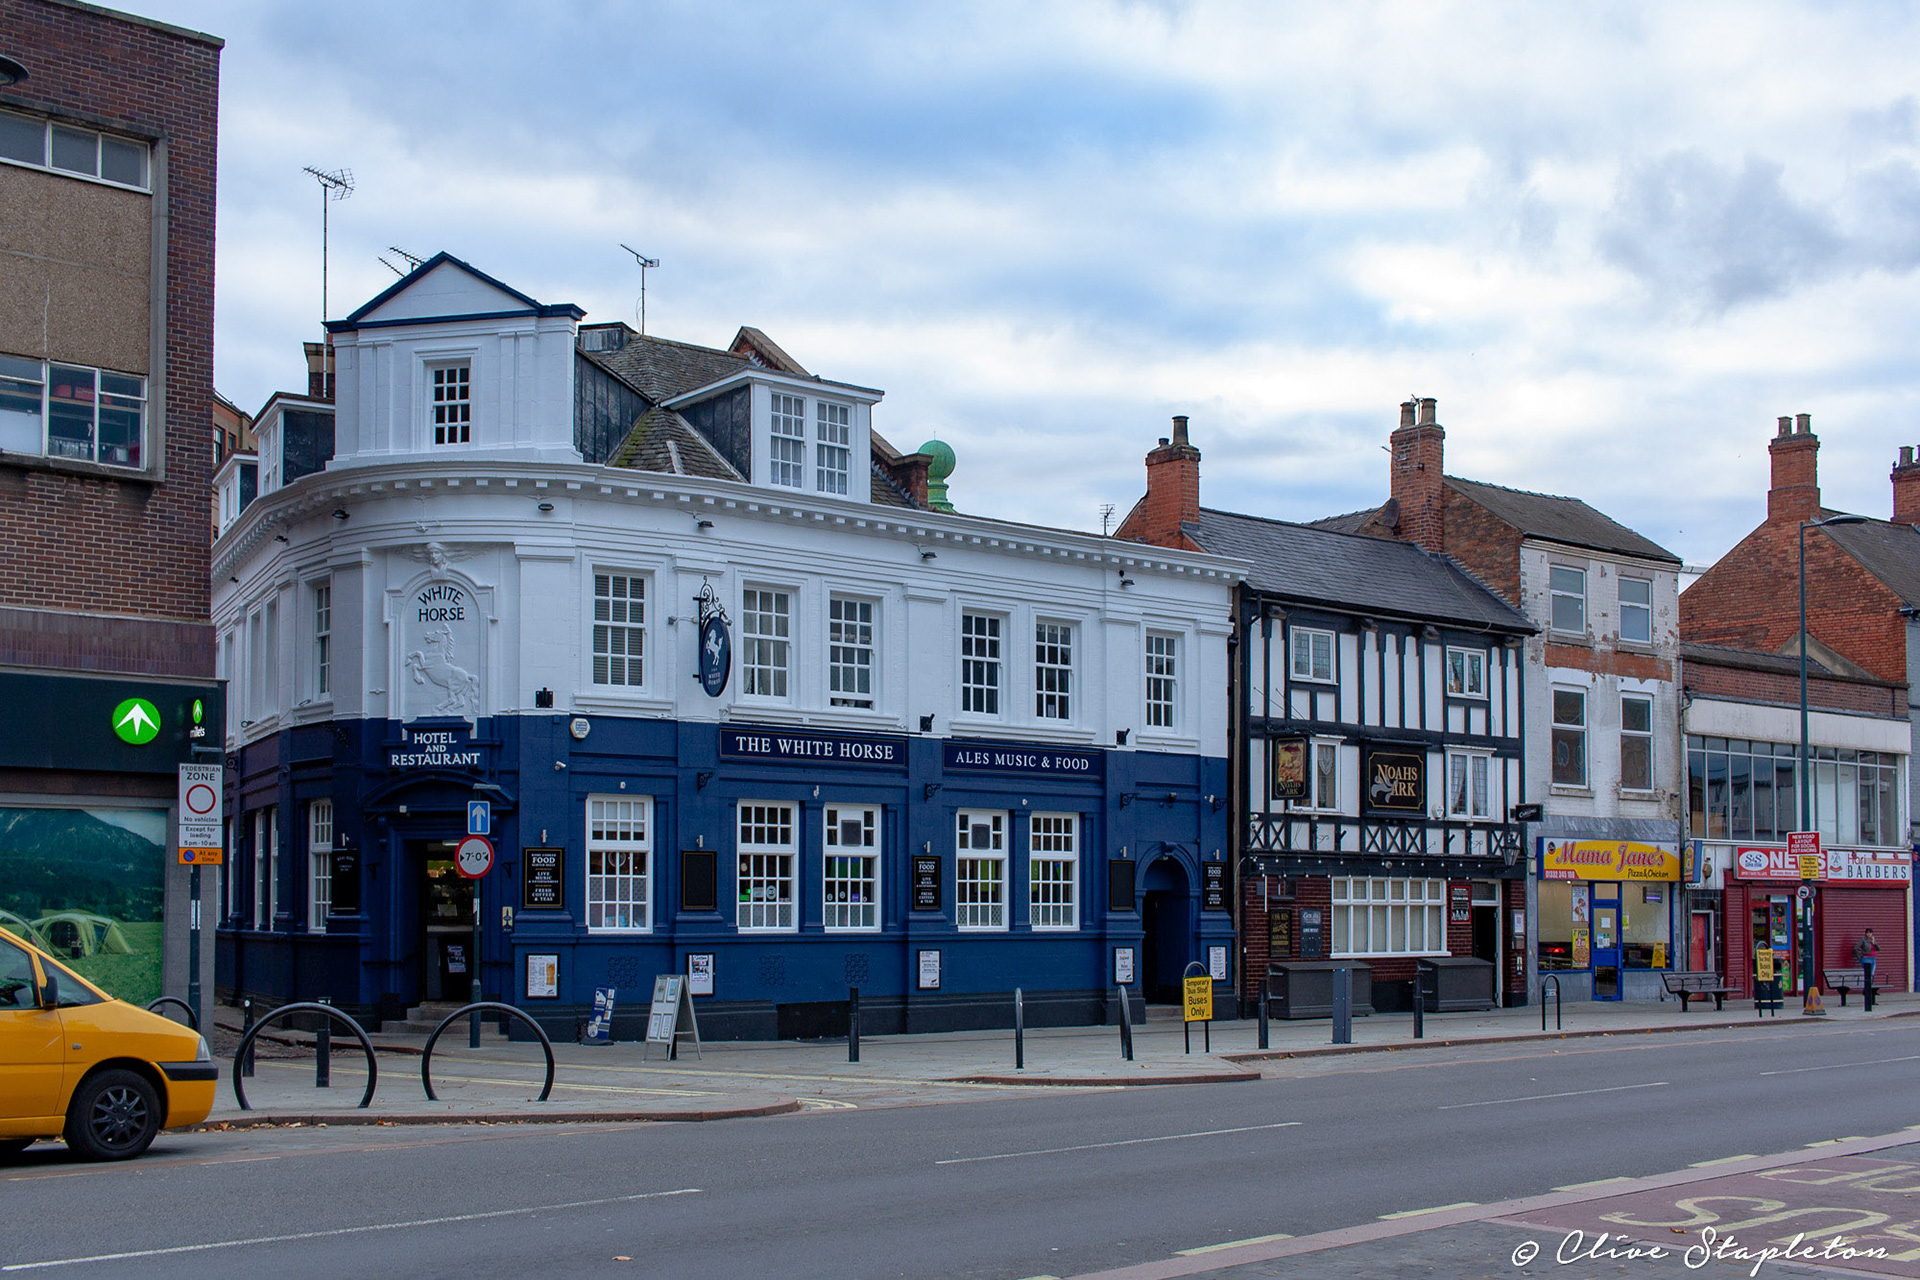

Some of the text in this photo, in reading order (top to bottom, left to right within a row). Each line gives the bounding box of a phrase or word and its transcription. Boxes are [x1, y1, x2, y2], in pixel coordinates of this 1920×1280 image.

[417, 585, 465, 606] WHITE
[418, 606, 466, 622] HORSE
[414, 732, 457, 744] HOTEL
[425, 744, 446, 753] AND
[736, 736, 894, 760] THE WHITE HORSE
[391, 752, 480, 766] RESTAURANT
[956, 751, 1089, 770] ALES MUSIC & FOOD
[186, 772, 215, 781] ZONE
[1377, 764, 1418, 784] NOAHS
[1279, 781, 1302, 791] NOAHS
[1391, 782, 1416, 797] ARK
[1555, 841, 1612, 865] Mama
[1616, 842, 1665, 873] Jane's
[1769, 850, 1826, 869] NES
[1847, 852, 1866, 865] Hari
[1847, 865, 1907, 878] BARBERS
[1188, 995, 1208, 1005] Buses
[1190, 1007, 1205, 1017] Only
